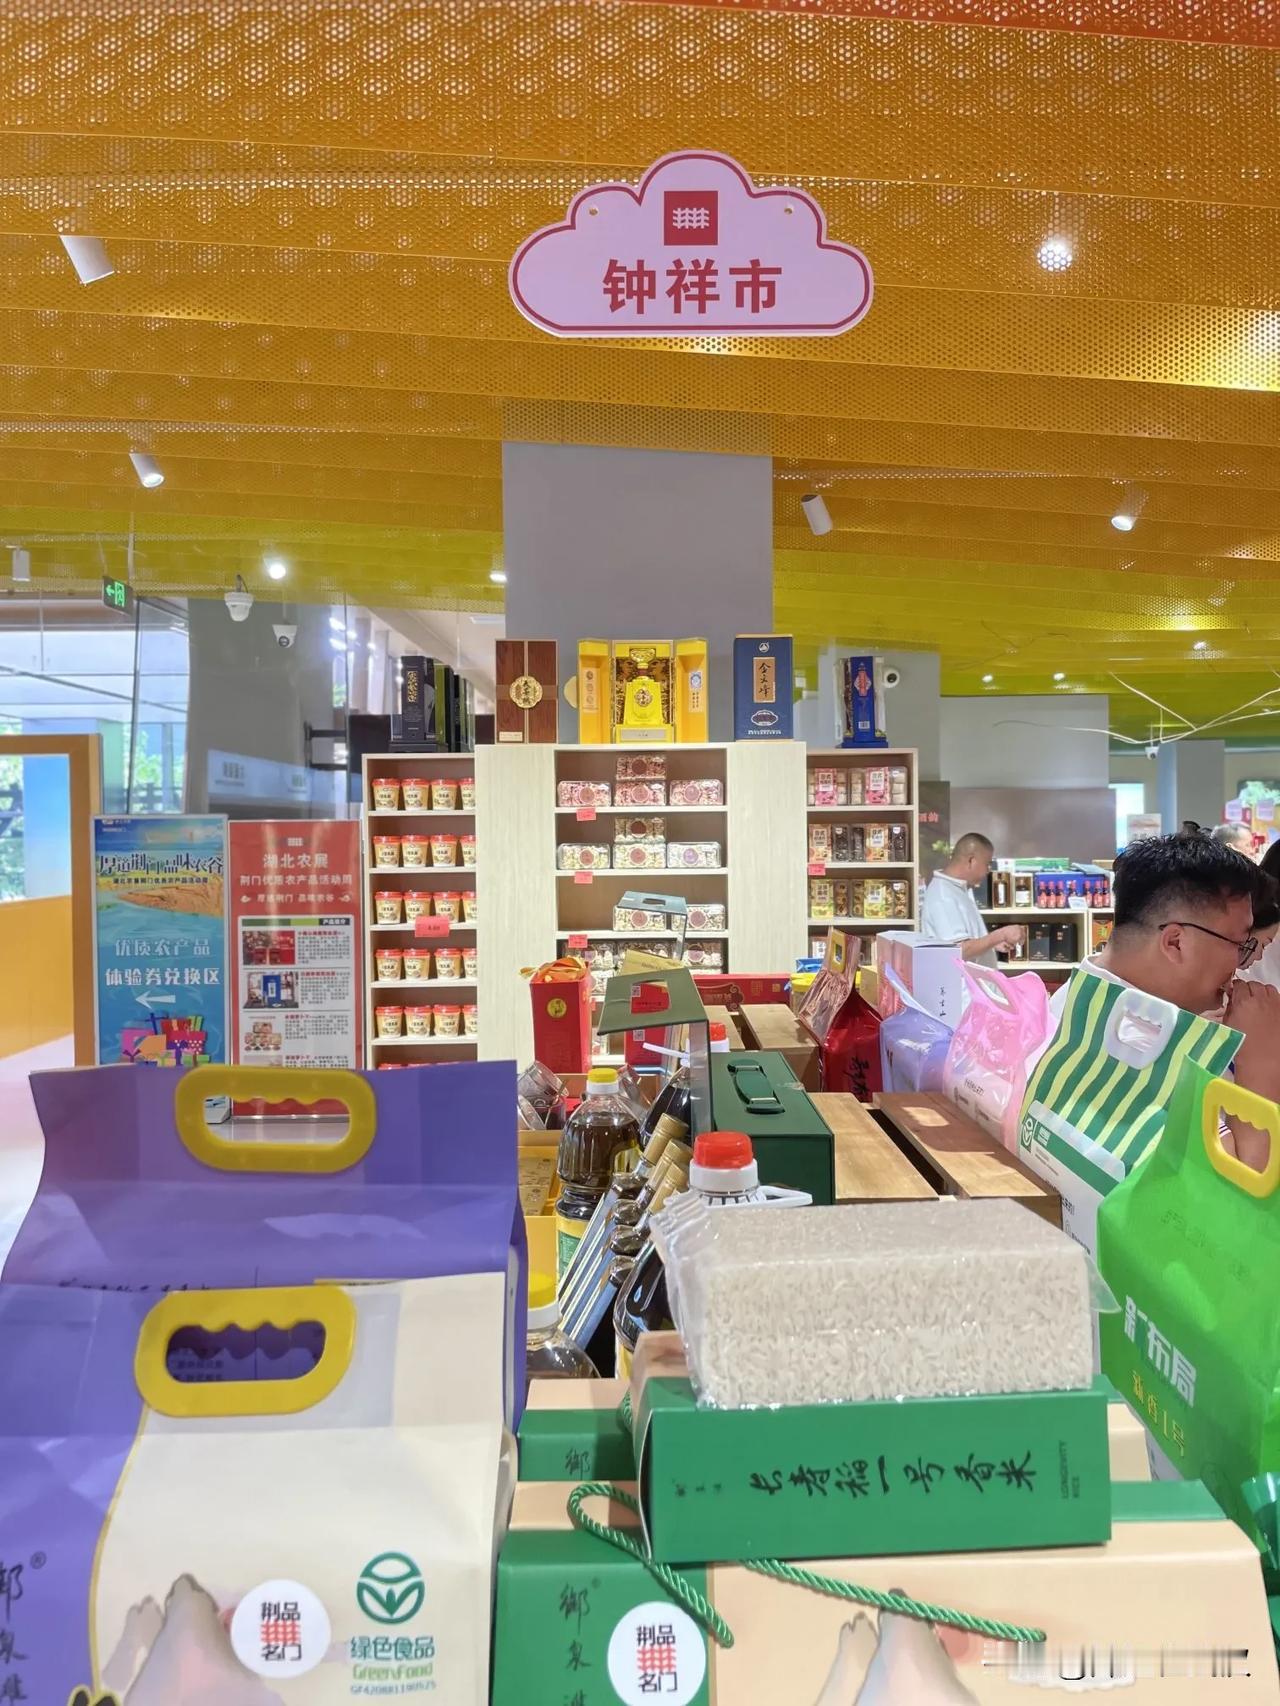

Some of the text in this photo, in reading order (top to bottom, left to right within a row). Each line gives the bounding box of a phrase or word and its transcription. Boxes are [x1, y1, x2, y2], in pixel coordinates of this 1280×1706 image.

[602, 258, 782, 314] 钟祥市
[263, 853, 328, 869] 湖北农展
[115, 938, 210, 956] 优质农产品
[105, 967, 220, 986] 体验券兑换区
[636, 1624, 676, 1646] 荆品
[260, 1643, 303, 1661] 名门
[350, 1635, 435, 1661] 绿色食品
[637, 1671, 679, 1693] 名门
